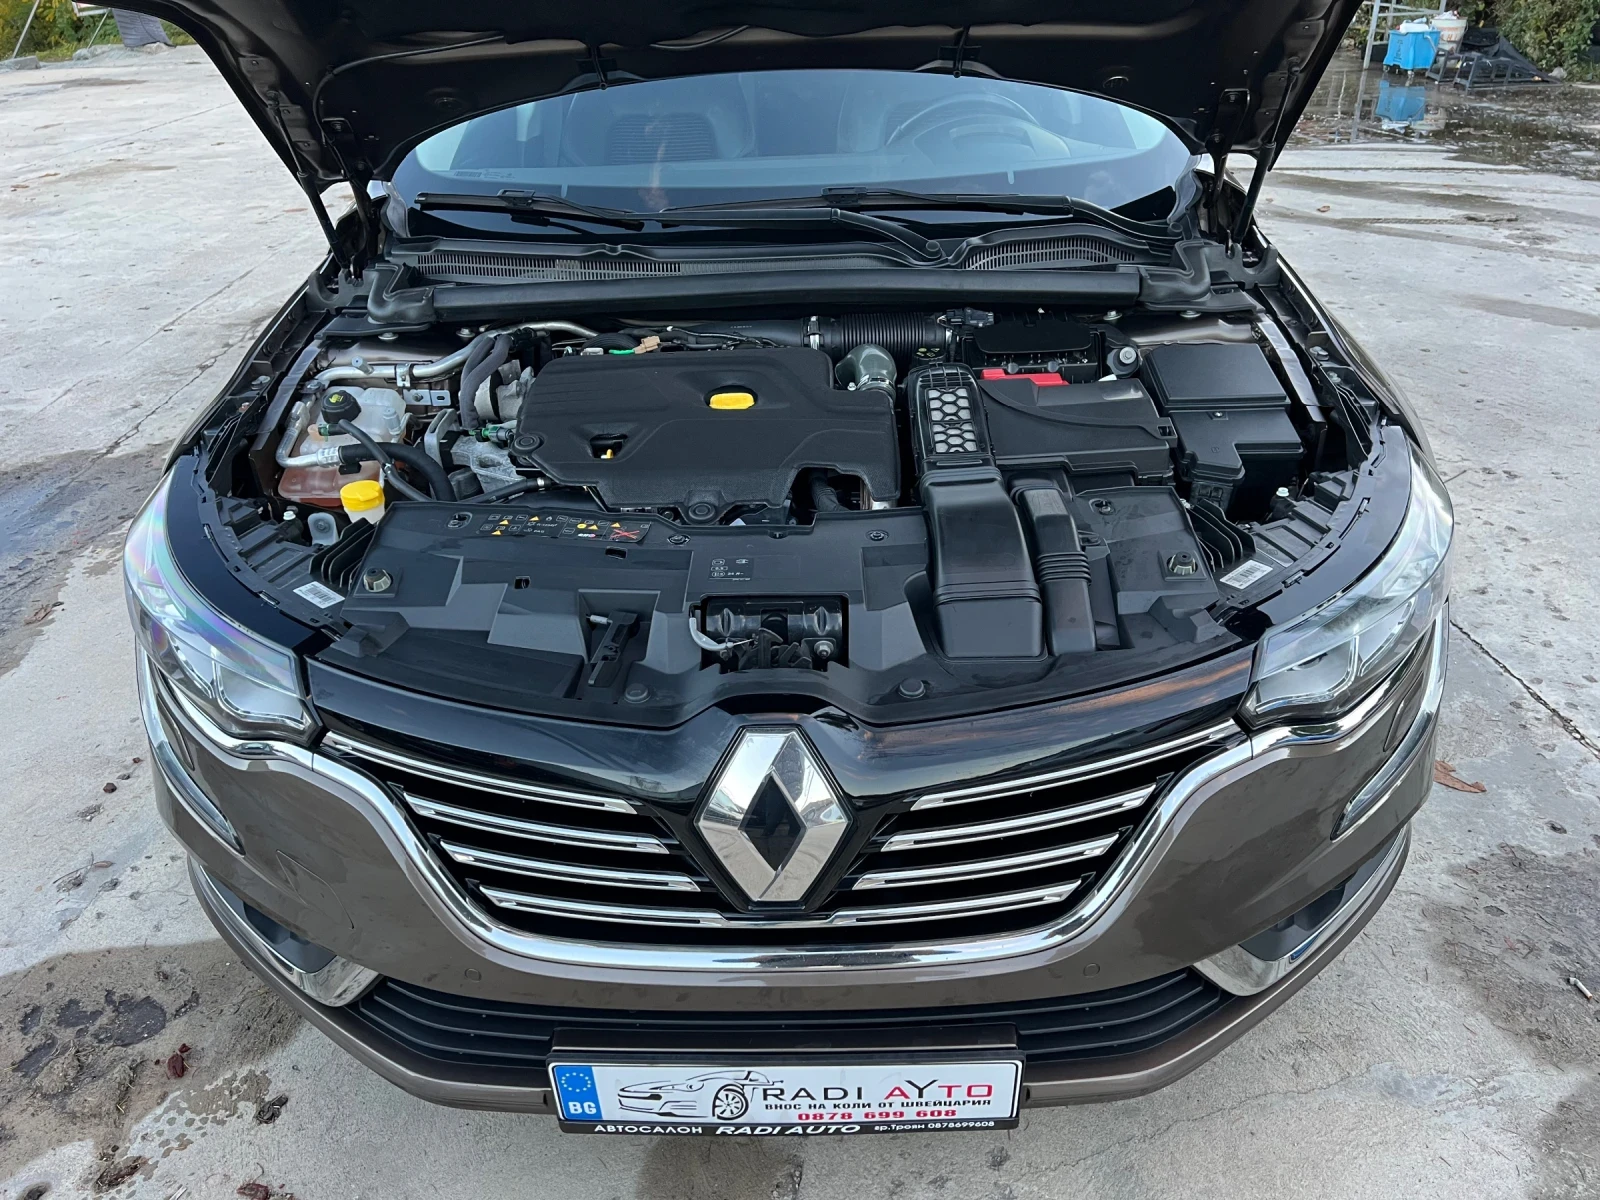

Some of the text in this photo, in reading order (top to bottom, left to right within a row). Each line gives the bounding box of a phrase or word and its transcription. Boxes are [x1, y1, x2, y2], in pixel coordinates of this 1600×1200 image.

[762, 1087, 863, 1101] RADI
[568, 1101, 597, 1115] BG
[901, 1099, 991, 1107] ШВЕЙЦАРИЯ
[798, 1109, 957, 1121] 0878 699 608
[594, 1125, 703, 1134] АВТОСАЛОН
[715, 1125, 861, 1135] RADI AUTO
